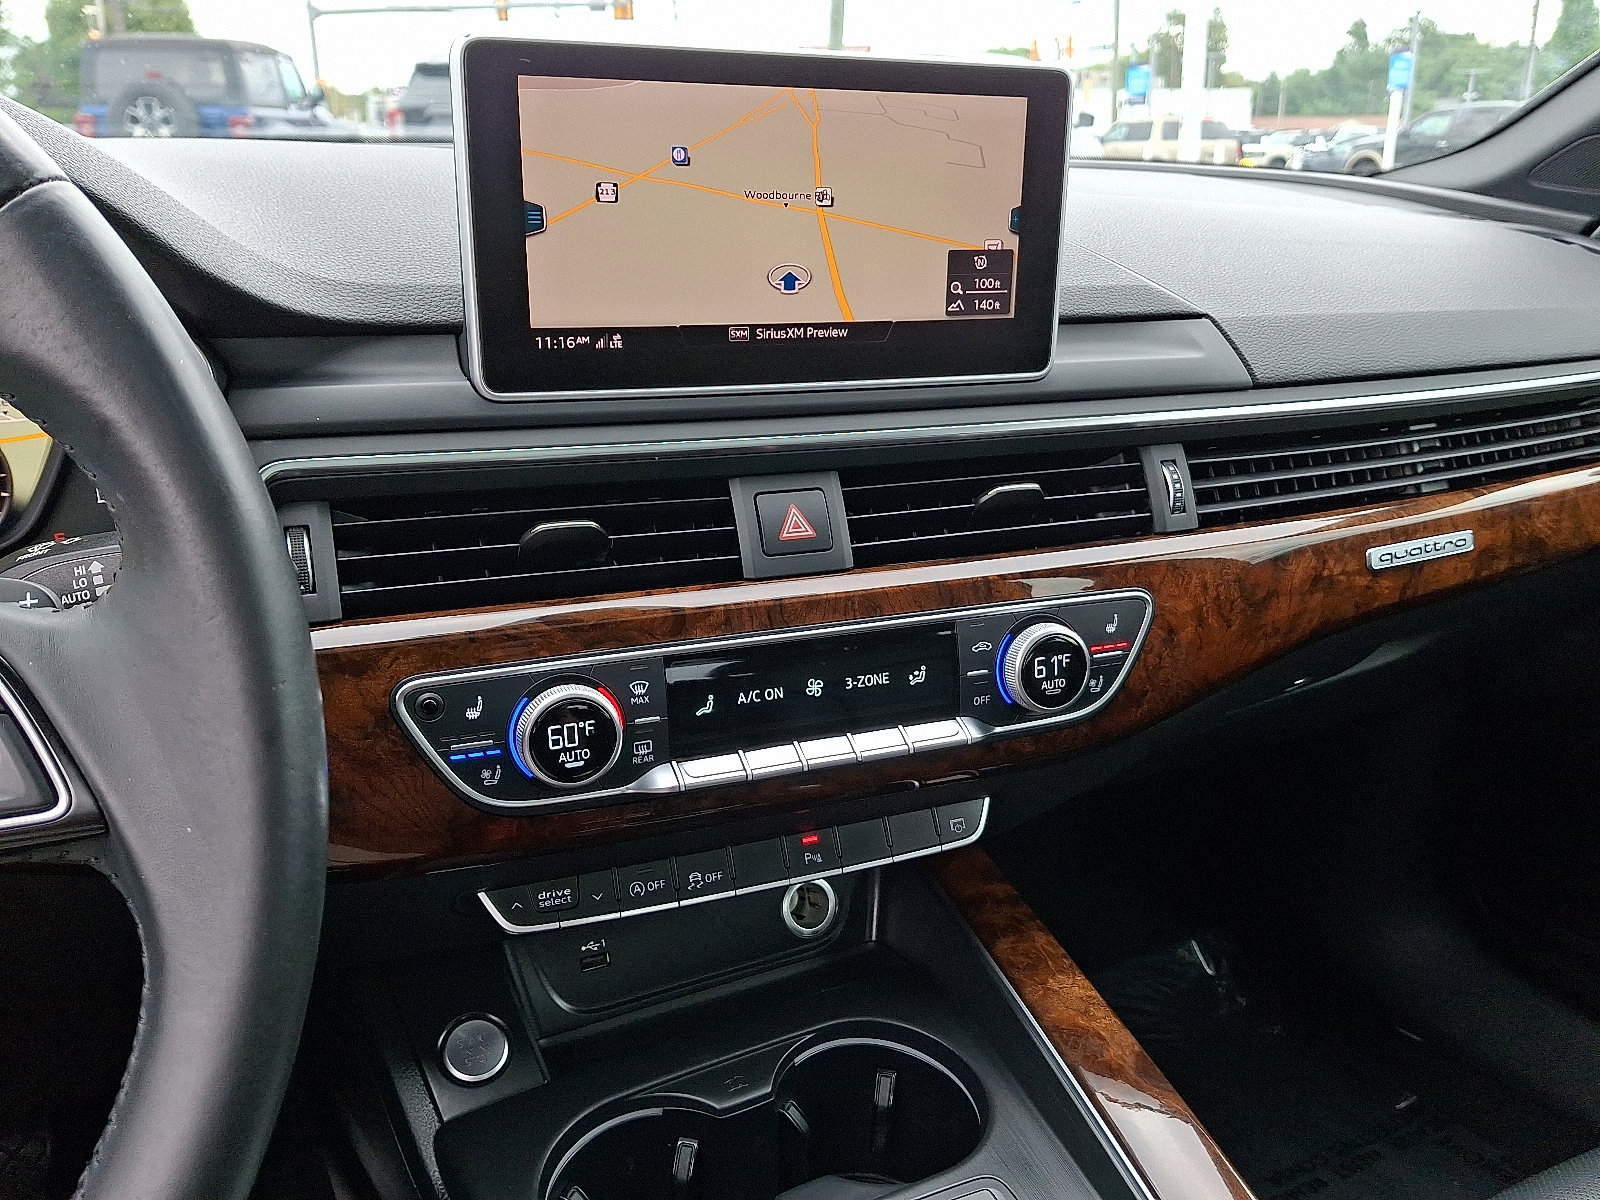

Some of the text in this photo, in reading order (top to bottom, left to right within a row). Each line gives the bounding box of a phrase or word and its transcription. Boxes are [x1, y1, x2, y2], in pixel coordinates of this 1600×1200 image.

[599, 188, 616, 196] 213
[744, 190, 812, 200] Woodbourne
[756, 326, 804, 340] SiriusXM
[806, 326, 849, 338] Preview
[609, 340, 623, 349] LTE
[1379, 538, 1467, 564] quattro
[73, 565, 87, 577] HI
[72, 578, 88, 590] LO
[61, 590, 91, 605] AUTO
[845, 672, 890, 690] 3-ZONE
[1041, 678, 1066, 691] AUTO
[630, 696, 650, 705] MAX
[737, 687, 784, 705] A/C ON
[973, 694, 991, 706] OFF
[558, 749, 590, 763] AUTO
[632, 755, 655, 765] REAR
[705, 871, 724, 884] OFF
[647, 879, 667, 892] OFF
[537, 886, 572, 901] drive
[538, 896, 572, 909] select
